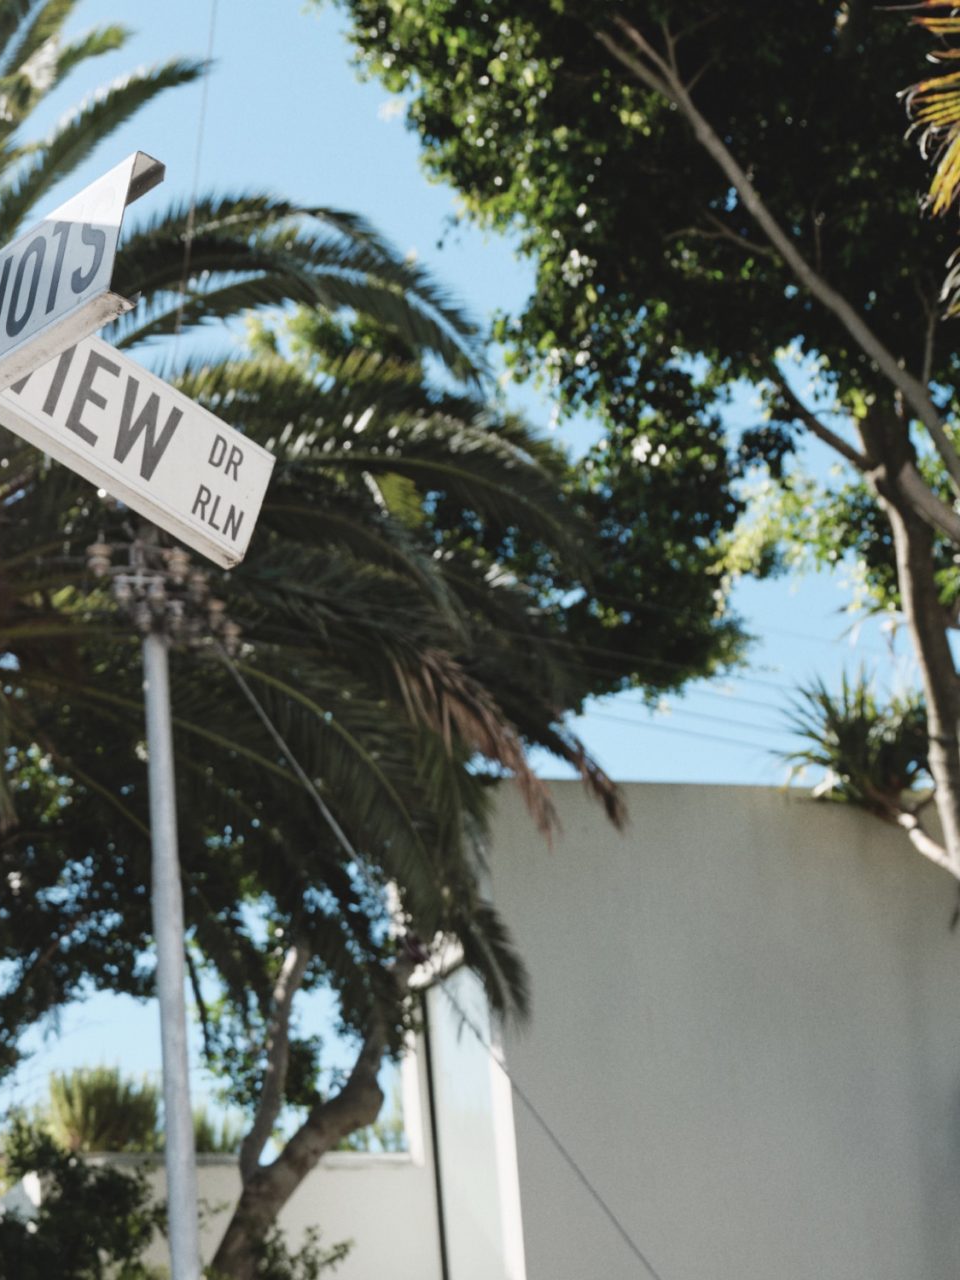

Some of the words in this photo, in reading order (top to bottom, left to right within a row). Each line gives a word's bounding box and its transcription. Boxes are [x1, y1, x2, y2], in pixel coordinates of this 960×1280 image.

[9, 344, 184, 482] IEW
[208, 434, 244, 482] DR
[191, 484, 244, 542] RLN
